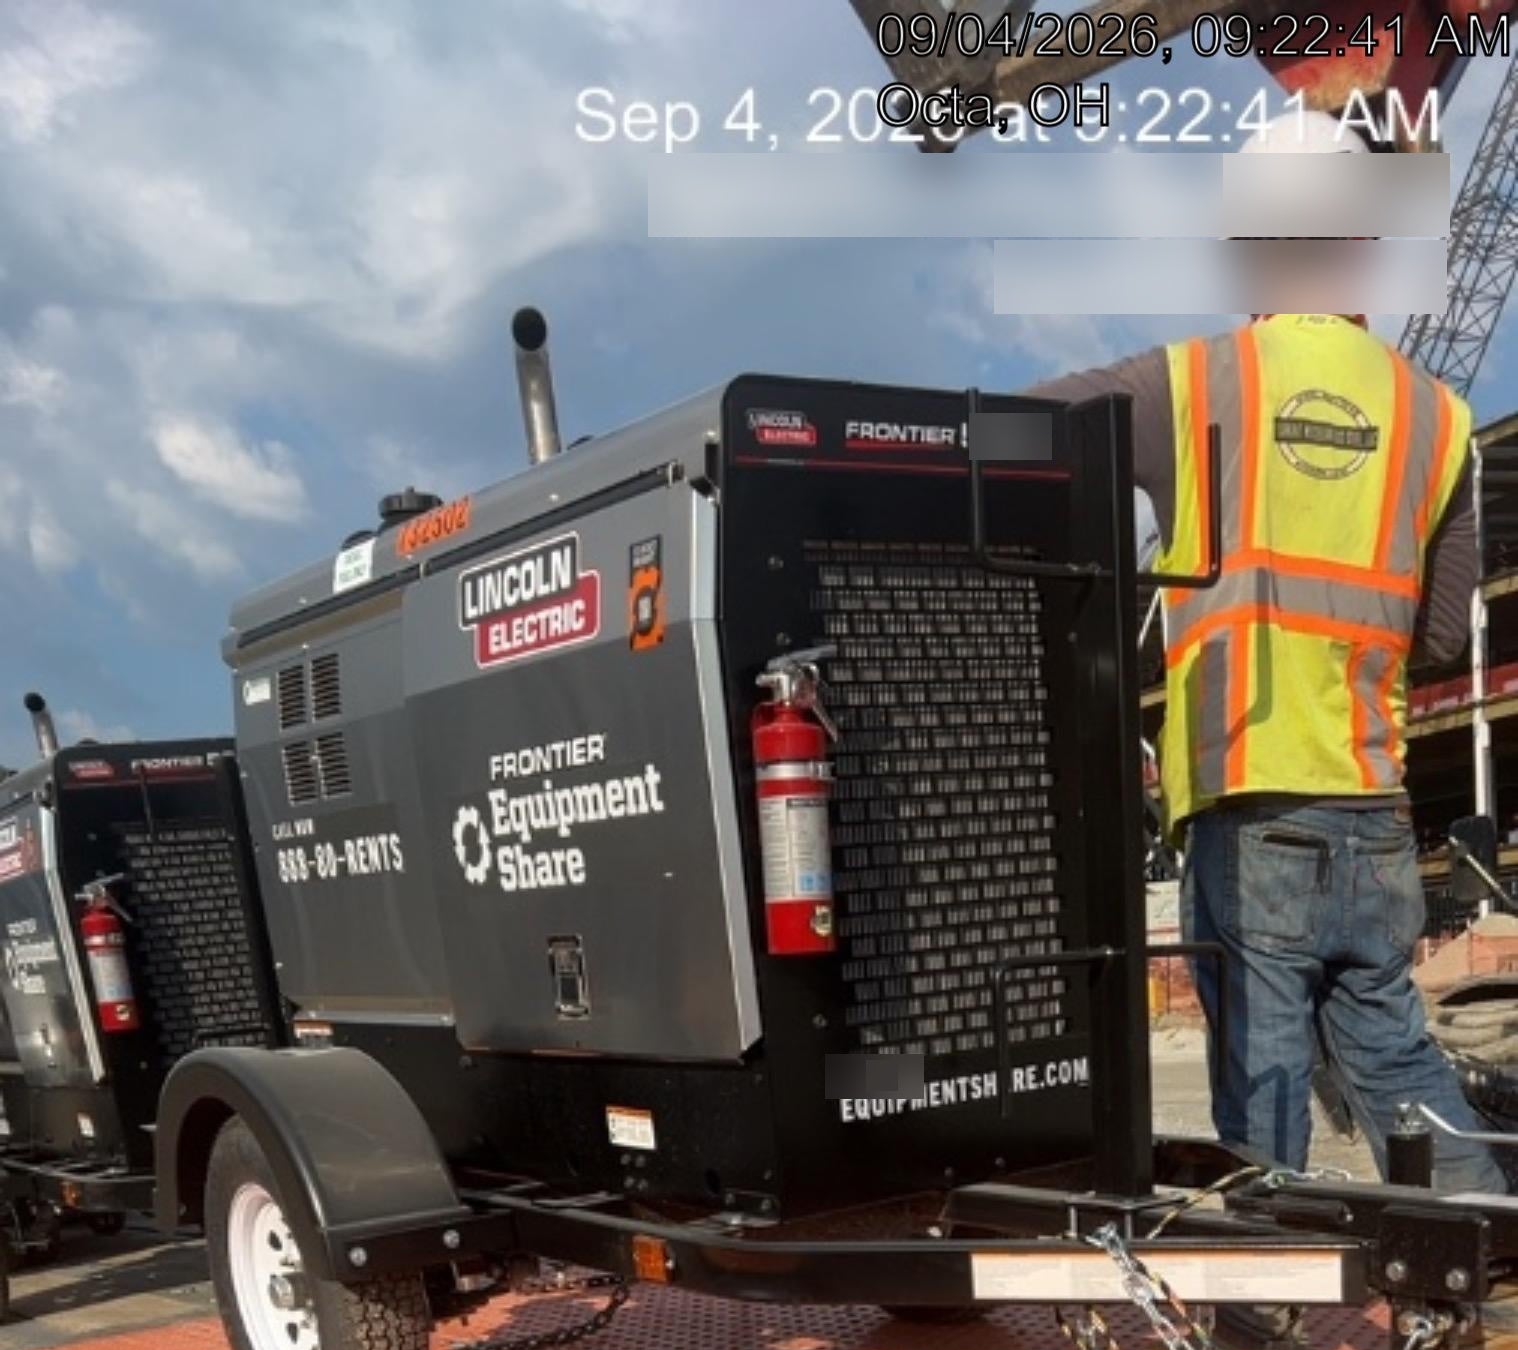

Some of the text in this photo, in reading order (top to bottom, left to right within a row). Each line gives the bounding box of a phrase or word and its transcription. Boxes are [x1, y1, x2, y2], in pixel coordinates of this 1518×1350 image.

[845, 421, 956, 445] FRONTIER
[464, 545, 571, 619] LINCOLN
[488, 599, 586, 655] ELECTRIC
[490, 733, 605, 782] FRONTIER
[488, 763, 665, 843] Equipment
[497, 844, 587, 892] Share
